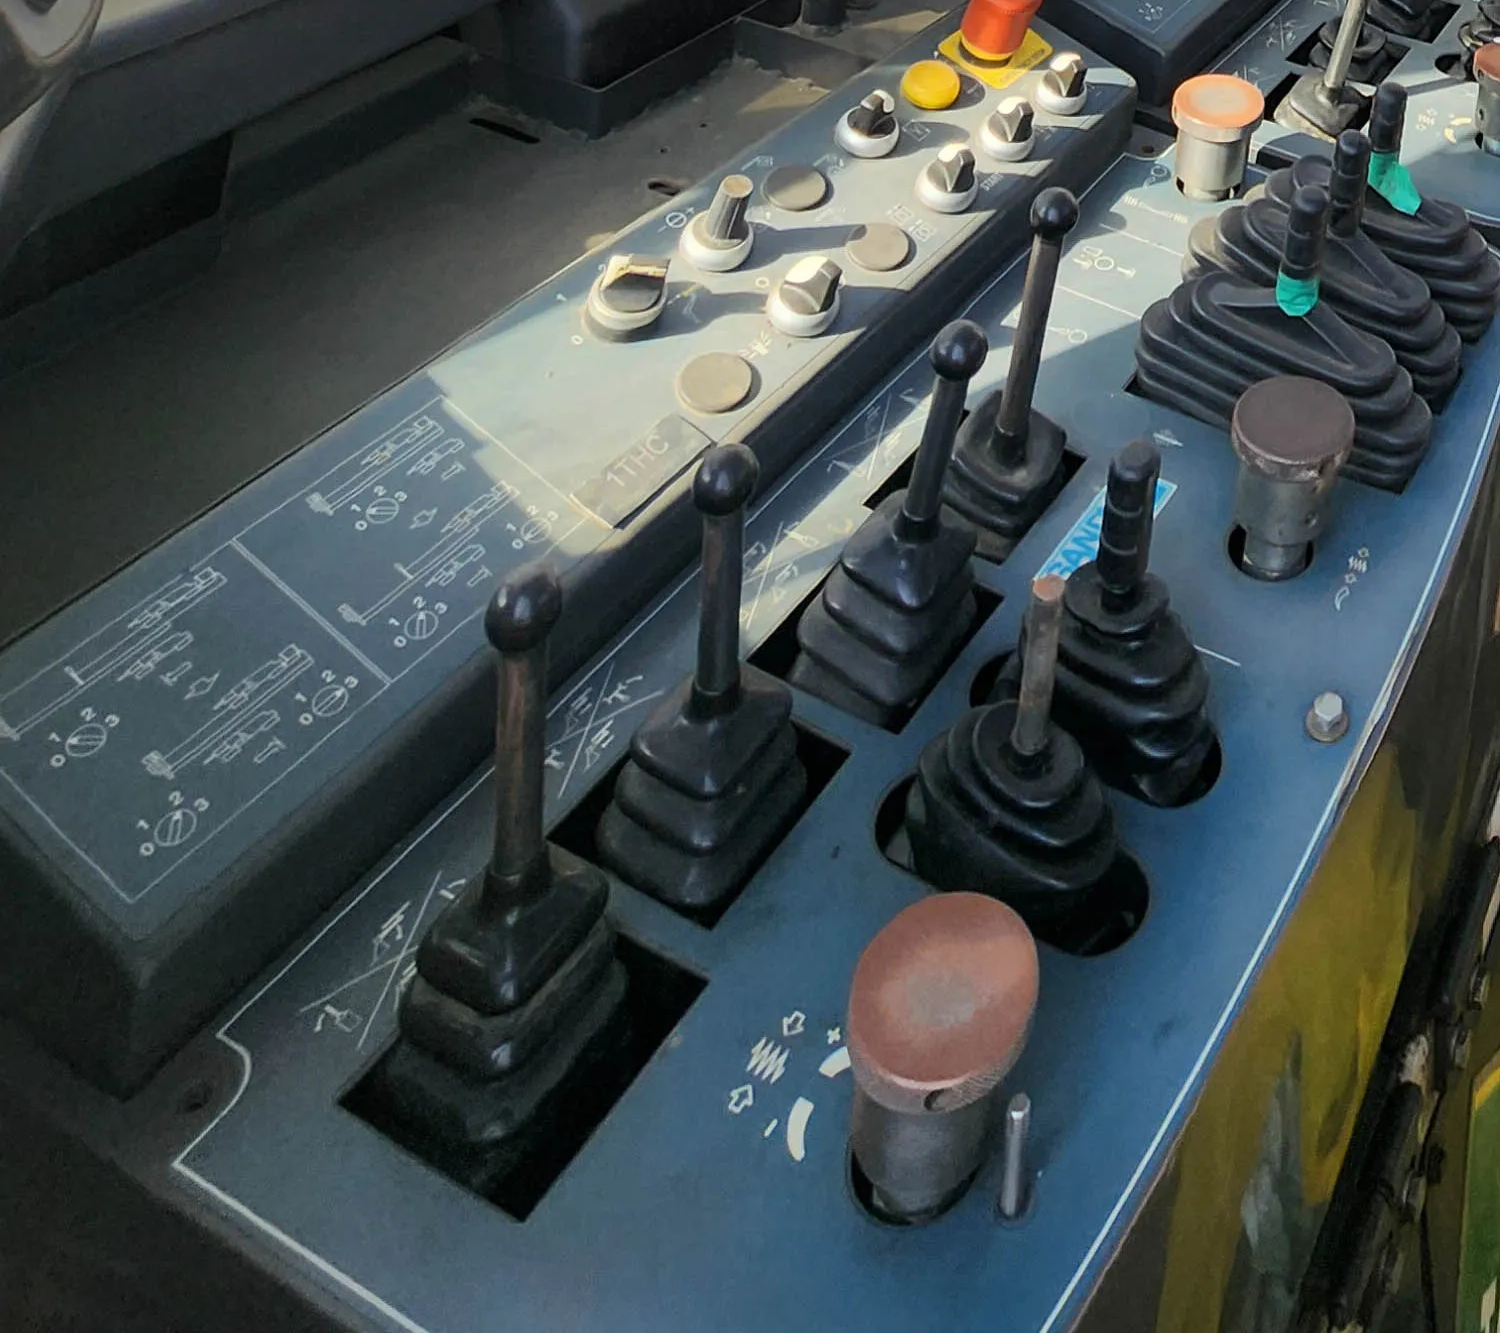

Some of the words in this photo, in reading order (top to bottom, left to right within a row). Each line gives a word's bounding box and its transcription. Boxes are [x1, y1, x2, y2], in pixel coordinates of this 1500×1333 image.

[606, 435, 670, 488] 1THC
[373, 485, 387, 497] 2
[394, 490, 408, 502] 3
[350, 503, 362, 513] 1
[527, 505, 539, 516] 2
[546, 511, 559, 522] 3
[355, 520, 368, 531] 0
[506, 522, 518, 532] 1
[511, 538, 524, 550] 0
[413, 596, 427, 609] 2
[434, 602, 449, 614] 3
[387, 617, 401, 627] 1
[393, 635, 407, 648] 0
[321, 669, 337, 684] 2
[344, 675, 359, 689] 3
[294, 692, 307, 703] 1
[79, 706, 96, 722] 2
[104, 713, 120, 727] 3
[298, 712, 313, 726] 0
[48, 732, 61, 742] 1
[49, 754, 66, 768] 0
[168, 791, 184, 807] 2
[194, 797, 210, 812] 3
[136, 819, 150, 830] 1
[139, 842, 155, 857] 0
